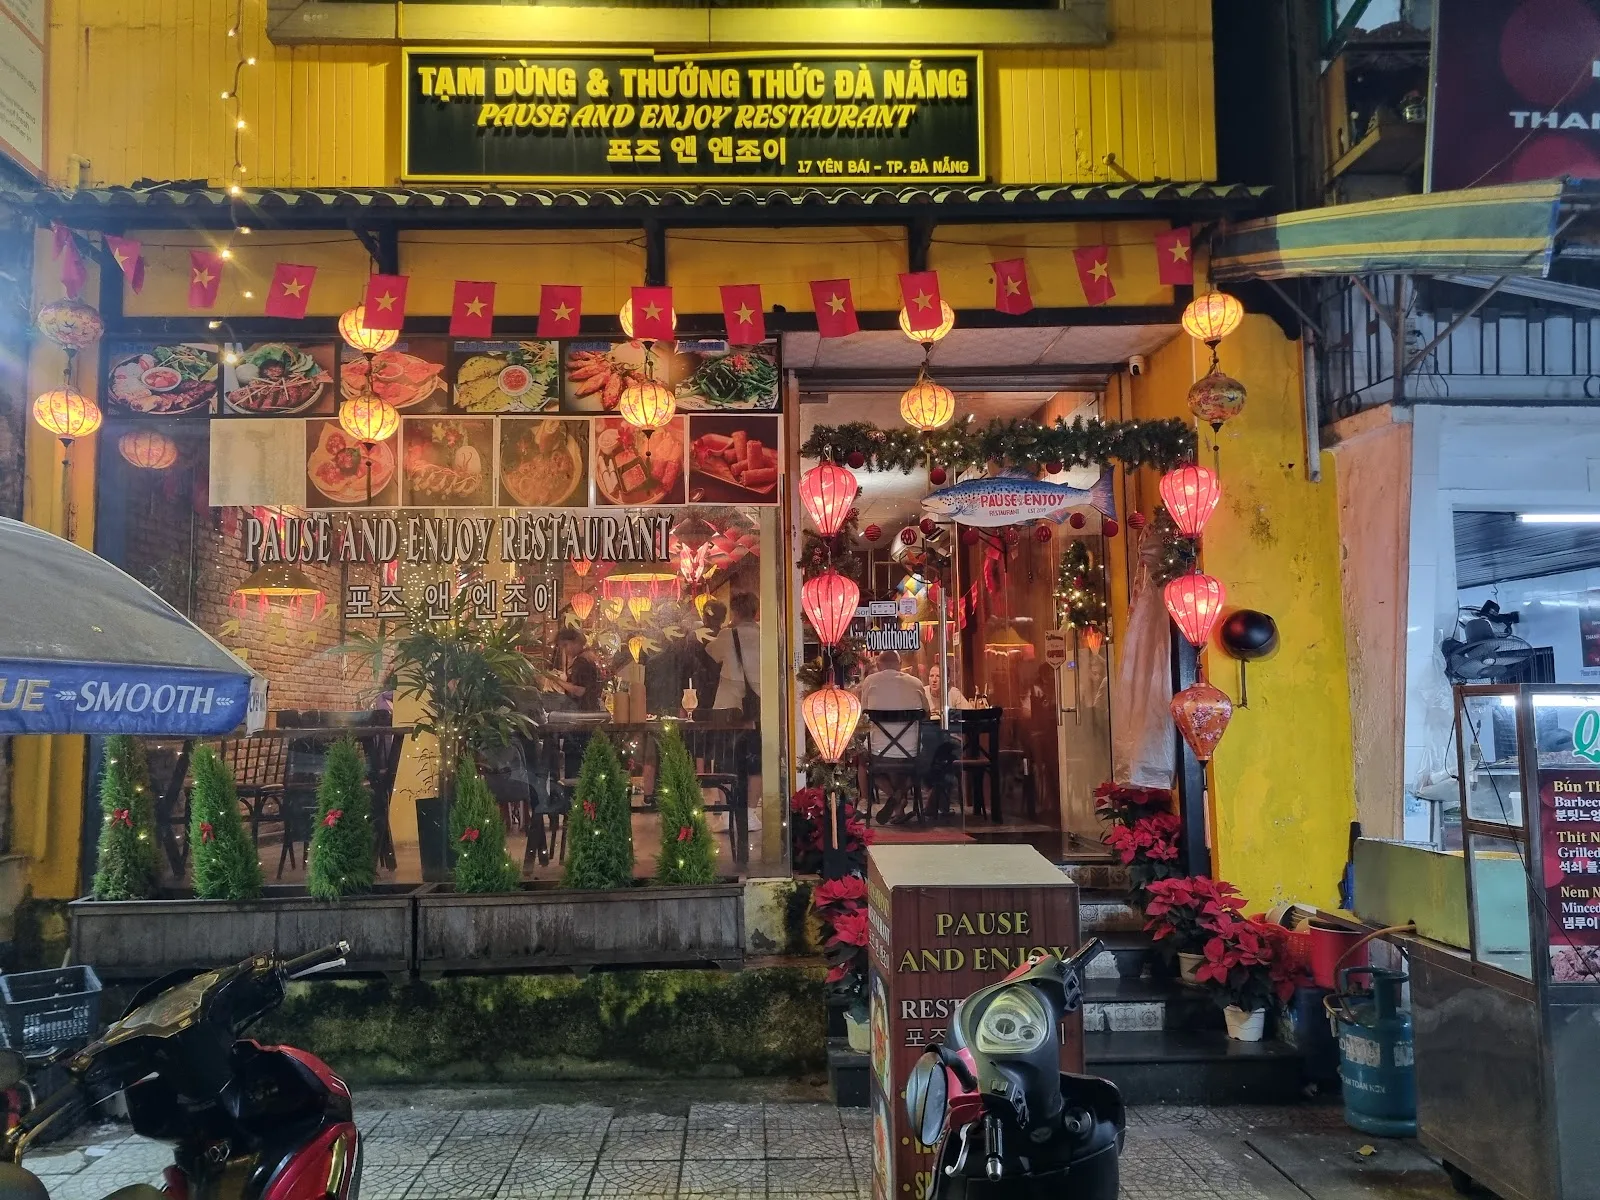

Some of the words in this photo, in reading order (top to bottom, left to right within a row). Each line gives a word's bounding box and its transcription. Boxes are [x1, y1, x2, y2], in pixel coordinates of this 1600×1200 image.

[418, 67, 485, 101] TẠM
[495, 59, 577, 97] DỪNG
[586, 68, 609, 97] &
[619, 61, 740, 98] THƯỞNG
[748, 63, 825, 99] THỨC
[834, 64, 875, 99] ĐÀ
[883, 59, 968, 99] NẴNG
[477, 103, 570, 128] PAUSE
[571, 103, 635, 128] AND
[639, 103, 733, 130] ENJOY
[734, 104, 917, 129] RESTAURANT
[606, 139, 661, 162] 포즈
[671, 135, 697, 164] 앤
[707, 136, 787, 165] 엔조이
[797, 160, 811, 174] 17
[817, 158, 843, 174] YÊN
[848, 158, 870, 174] BÁI
[886, 160, 907, 174] TP.
[910, 158, 929, 174] ĐÀ
[933, 156, 969, 174] NẴNG
[980, 493, 1017, 507] PAUSE
[1024, 494, 1065, 506] ENJOY
[246, 516, 333, 564] PAUSE
[340, 516, 401, 563] AND
[406, 515, 494, 565] ENJOY
[500, 514, 674, 564] RESTAURANT
[345, 584, 407, 619] 포즈
[424, 582, 450, 620] 앤
[471, 579, 559, 620] 엔조이
[76, 681, 215, 715] SMOOTH
[1553, 780, 1582, 793] Bún
[1557, 831, 1587, 845] Thịt
[1557, 846, 1600, 858] Grilled
[1586, 860, 1600, 874] 불
[1560, 886, 1589, 898] Nem
[1561, 902, 1600, 913] Minced
[935, 910, 1031, 936] PAUSE
[897, 948, 964, 973] AND
